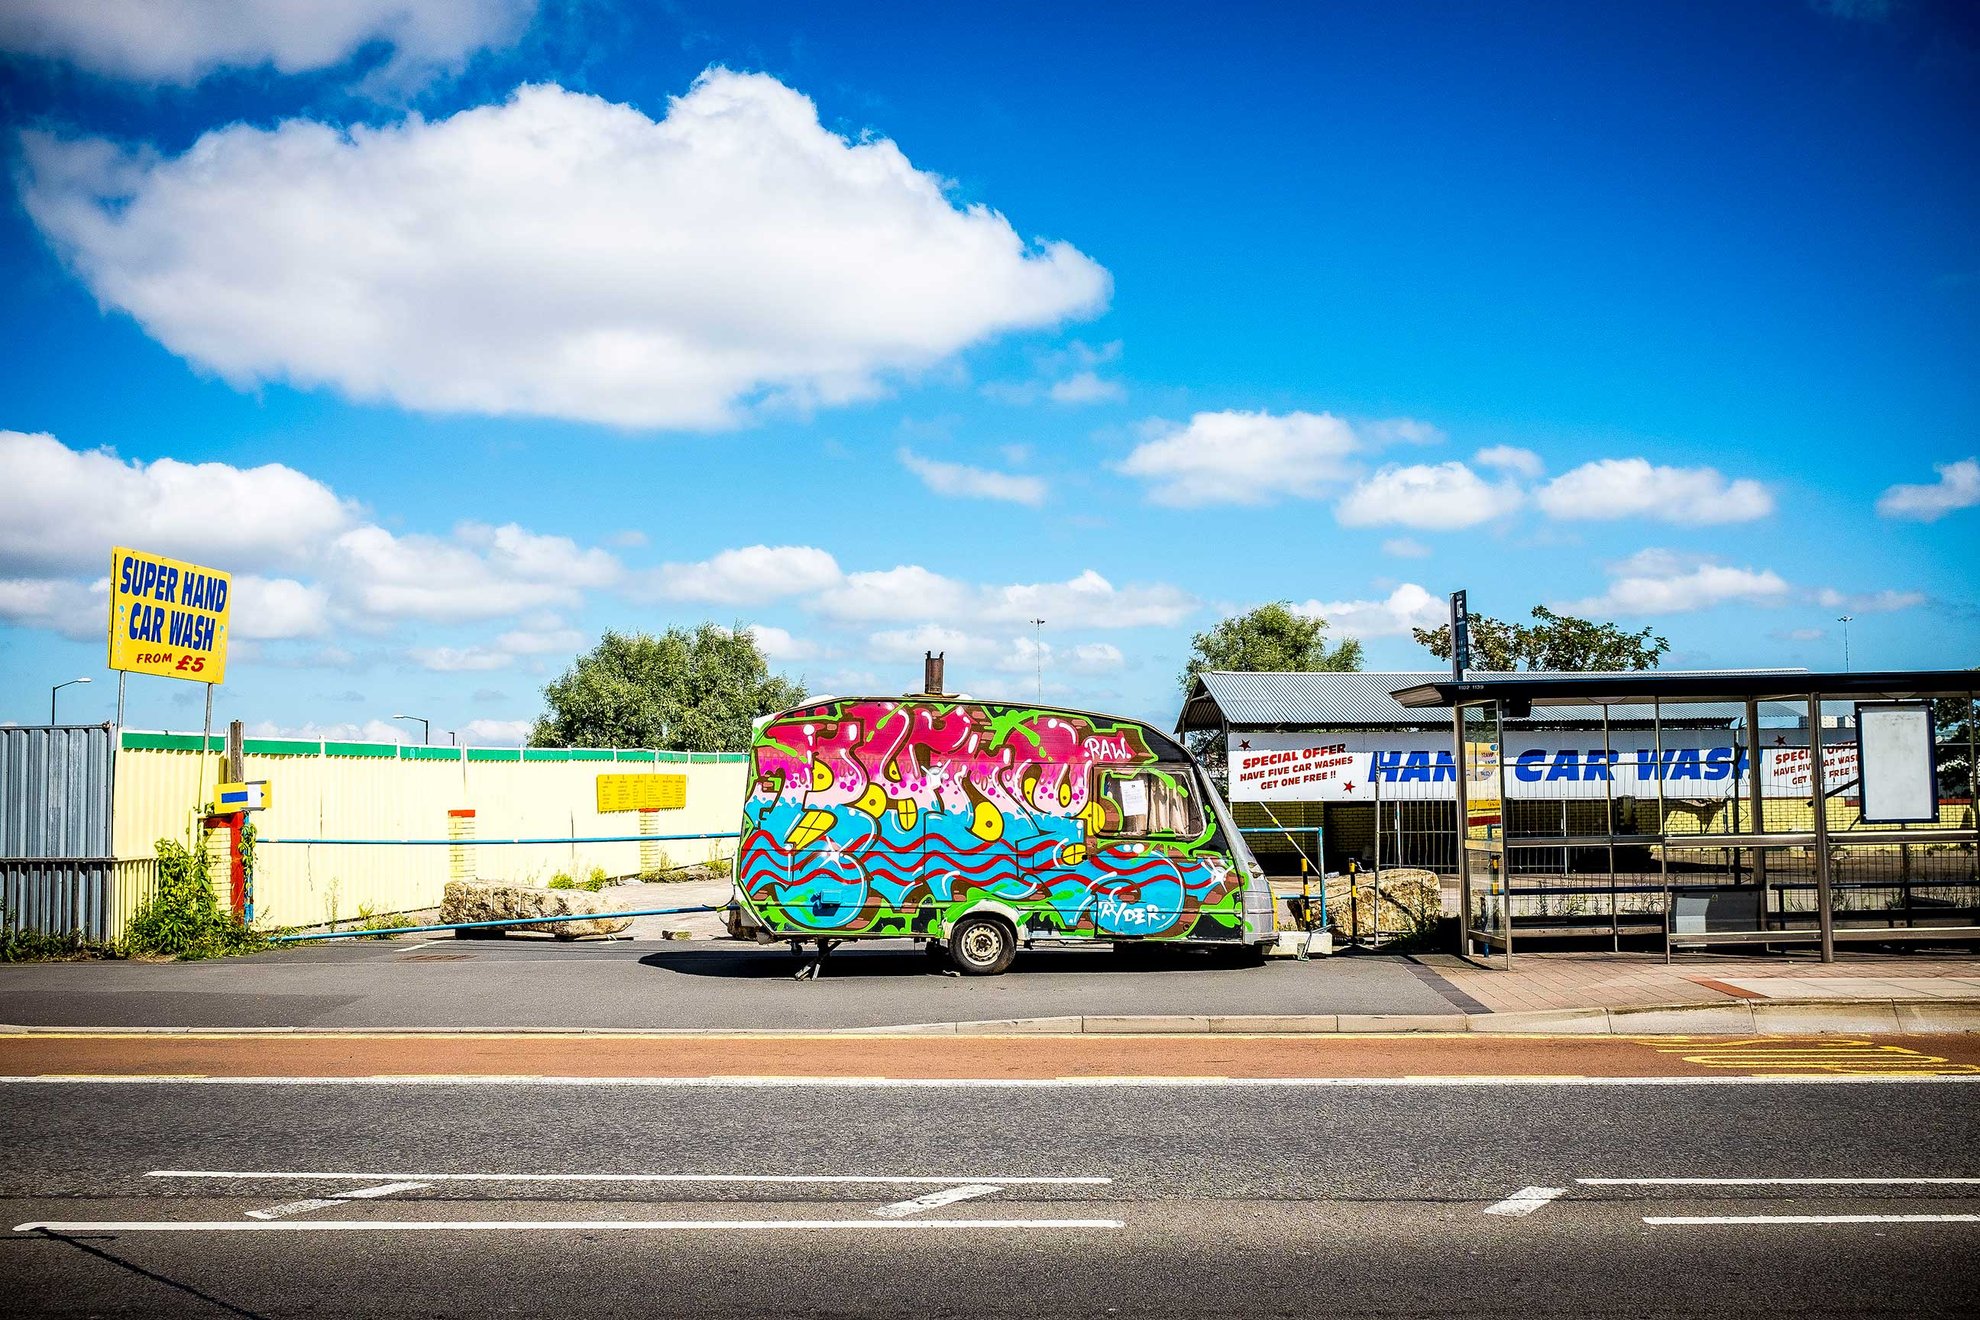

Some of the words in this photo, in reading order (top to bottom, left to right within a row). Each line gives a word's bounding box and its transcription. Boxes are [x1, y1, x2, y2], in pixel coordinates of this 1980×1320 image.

[120, 556, 179, 603] SUPER
[181, 571, 228, 613] HAND
[129, 602, 165, 644] CAR
[169, 610, 216, 652] WASH
[136, 653, 172, 664] FROM
[175, 654, 206, 672] £5
[1240, 770, 1266, 782] HAVE
[1268, 766, 1290, 777] FIVE
[1292, 763, 1312, 773] CAR
[1314, 756, 1353, 769] WASHES
[1242, 751, 1299, 770] SPECIAL
[1302, 743, 1346, 760] OFFER
[1368, 750, 1457, 782] HAN
[1514, 749, 1620, 782] CAR
[1773, 766, 1796, 777] HAVE
[1797, 763, 1811, 772] FIV
[1823, 758, 1835, 768] AR
[1260, 780, 1279, 790] GET
[1281, 776, 1300, 786] ONE
[1303, 771, 1328, 783] FREE
[1792, 776, 1807, 785] GET
[1828, 768, 1850, 778] FREE
